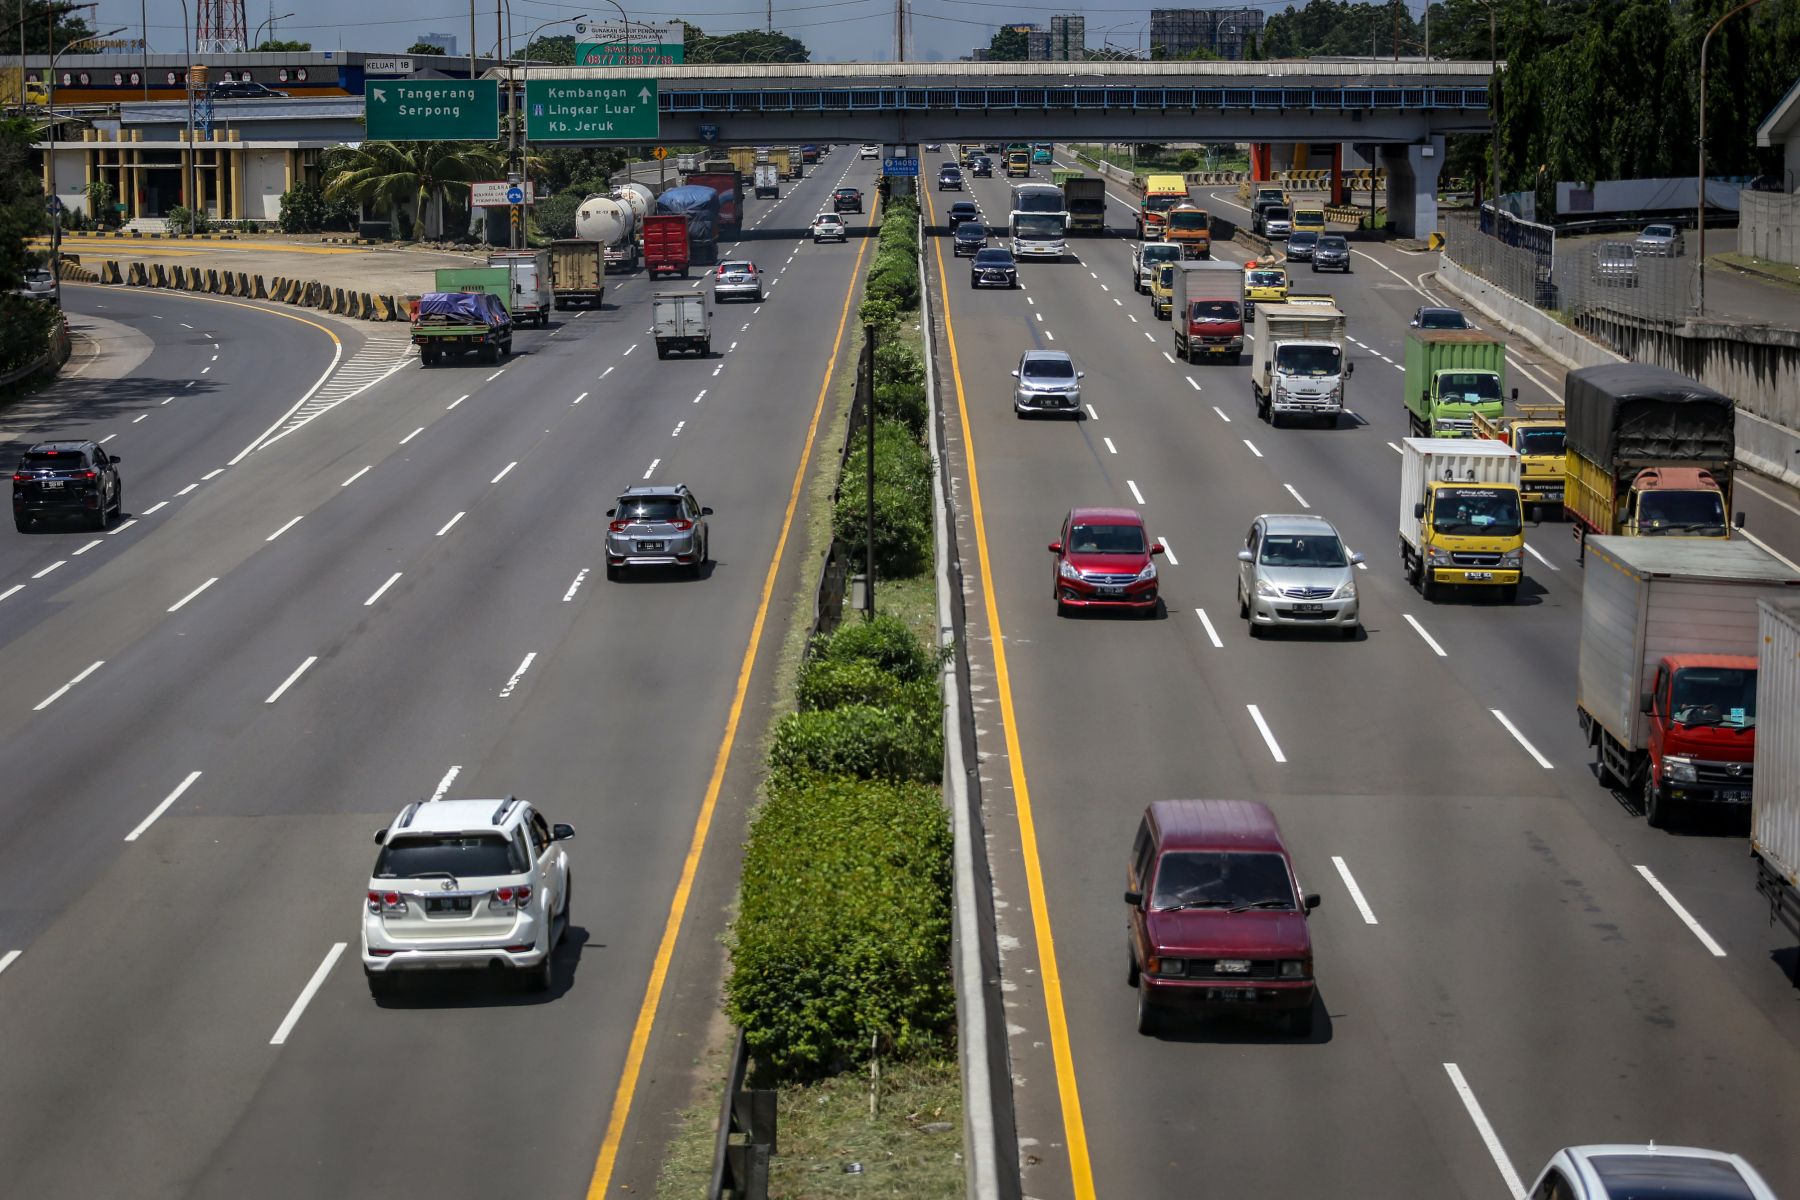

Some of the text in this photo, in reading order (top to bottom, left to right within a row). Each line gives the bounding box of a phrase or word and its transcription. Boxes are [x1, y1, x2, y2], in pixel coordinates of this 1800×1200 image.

[366, 62, 395, 70] KELUAR
[400, 61, 409, 69] 18
[398, 88, 475, 101] Tangerang
[548, 88, 627, 100] Kembangan
[398, 105, 460, 117] Serpong
[549, 104, 636, 117] Lingkar Luar
[549, 121, 614, 132] Kb. Jeruk
